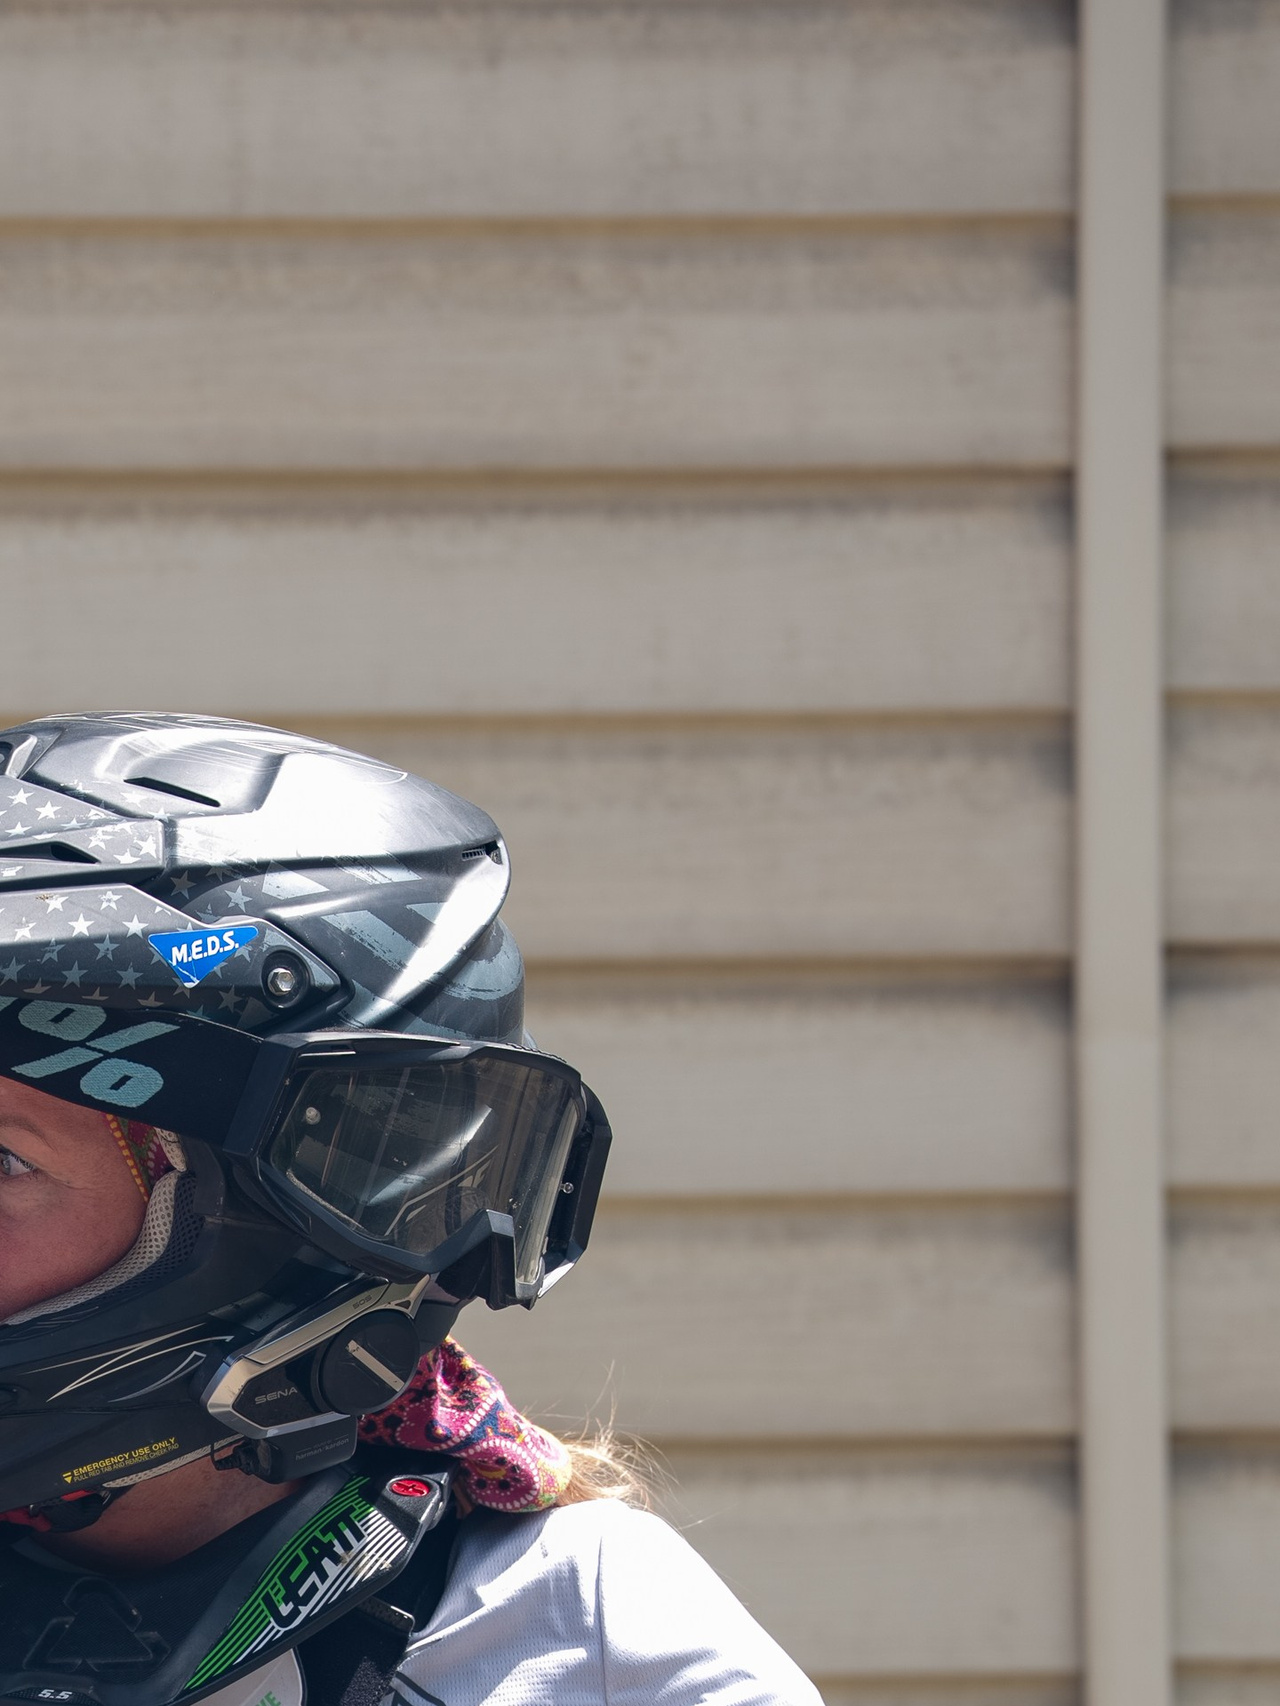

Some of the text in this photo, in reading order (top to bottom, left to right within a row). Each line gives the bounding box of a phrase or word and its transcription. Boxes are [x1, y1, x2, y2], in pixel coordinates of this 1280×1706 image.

[171, 930, 240, 966] M.E.D.S.
[254, 1386, 298, 1405] SENA
[72, 1437, 176, 1477] EMERGENCY USE ONLY
[73, 1442, 180, 1483] PULL RED TAB AND REMOVE CHEEK PAD
[260, 1502, 368, 1630] LEATT
[37, 1688, 73, 1700] 5.5
